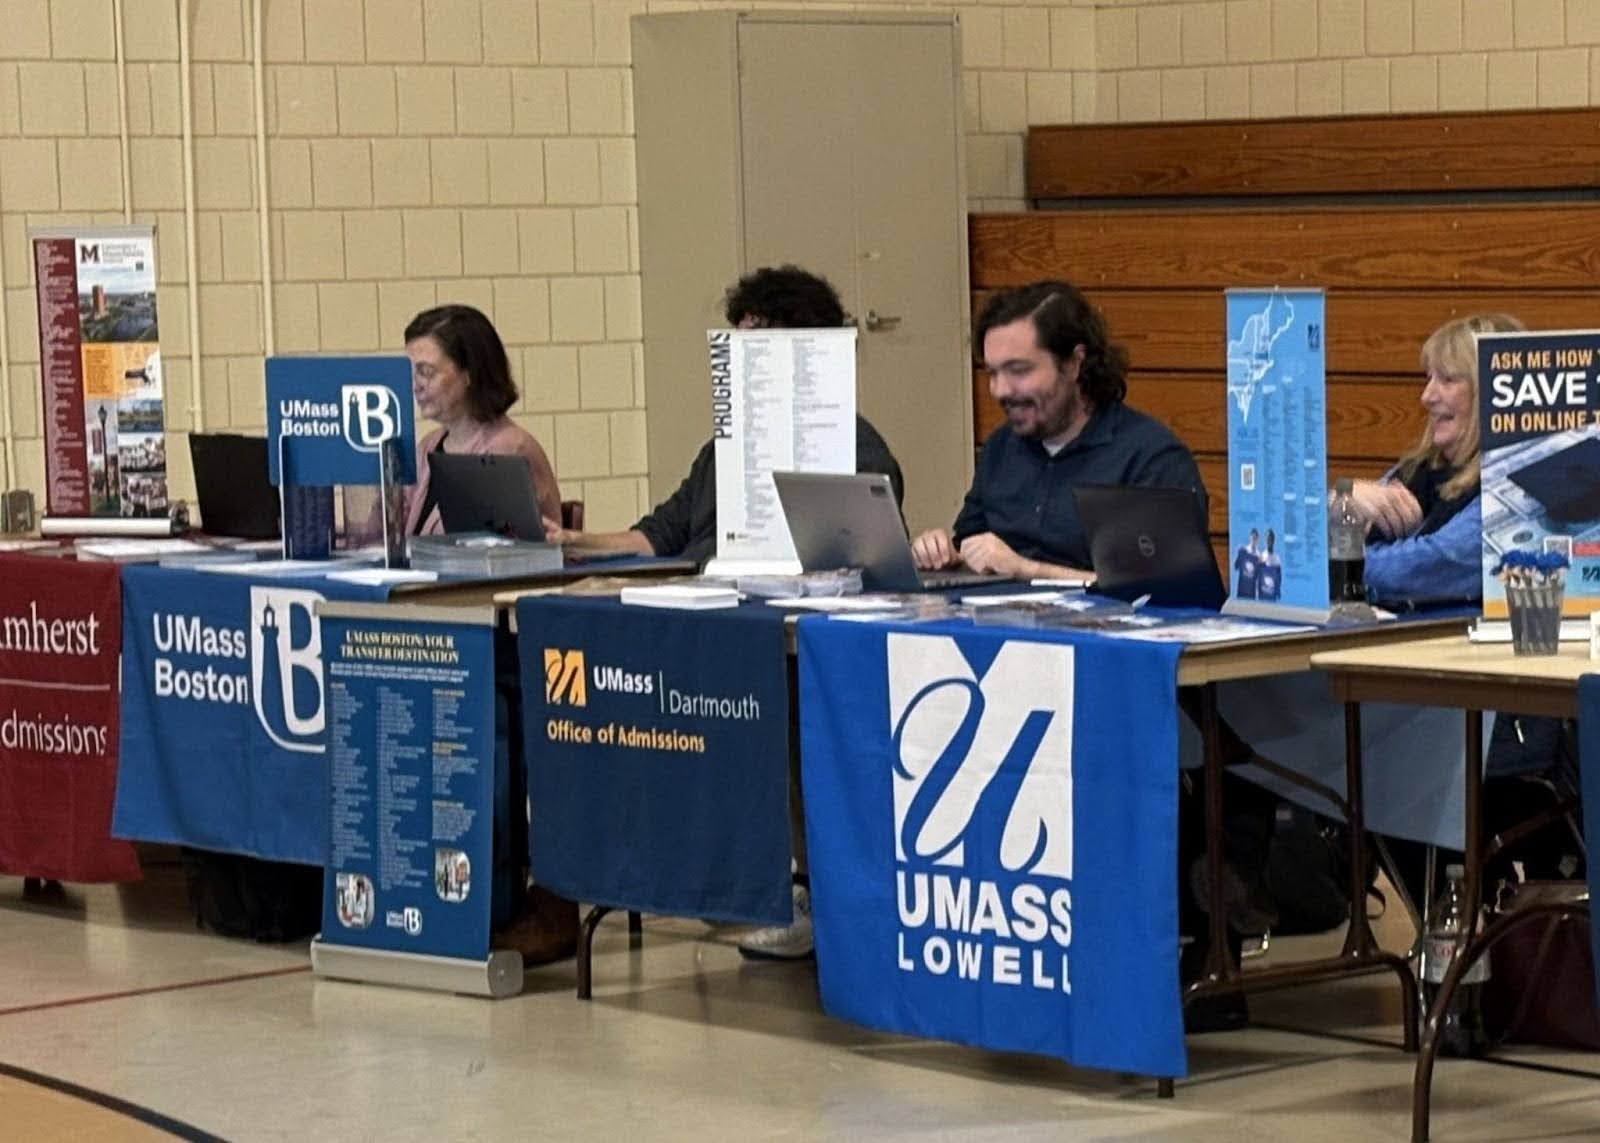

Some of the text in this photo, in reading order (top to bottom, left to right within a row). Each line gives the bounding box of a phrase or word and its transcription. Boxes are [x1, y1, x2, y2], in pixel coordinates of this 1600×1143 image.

[80, 244, 99, 262] M
[1491, 349, 1593, 370] ASK ME HOW
[711, 332, 733, 440] PROGRAMS
[1491, 371, 1587, 408] SAVE
[280, 400, 339, 417] UMass
[281, 418, 340, 436] Boston
[1491, 412, 1515, 433] ON
[1521, 410, 1587, 432] ONLINE
[0, 600, 100, 655] mherst
[153, 612, 247, 658] UMass
[154, 658, 248, 704] Boston
[593, 665, 760, 720] UMass Dartmouth
[547, 719, 705, 754] Office of Admissions
[896, 870, 1072, 948] UMASS
